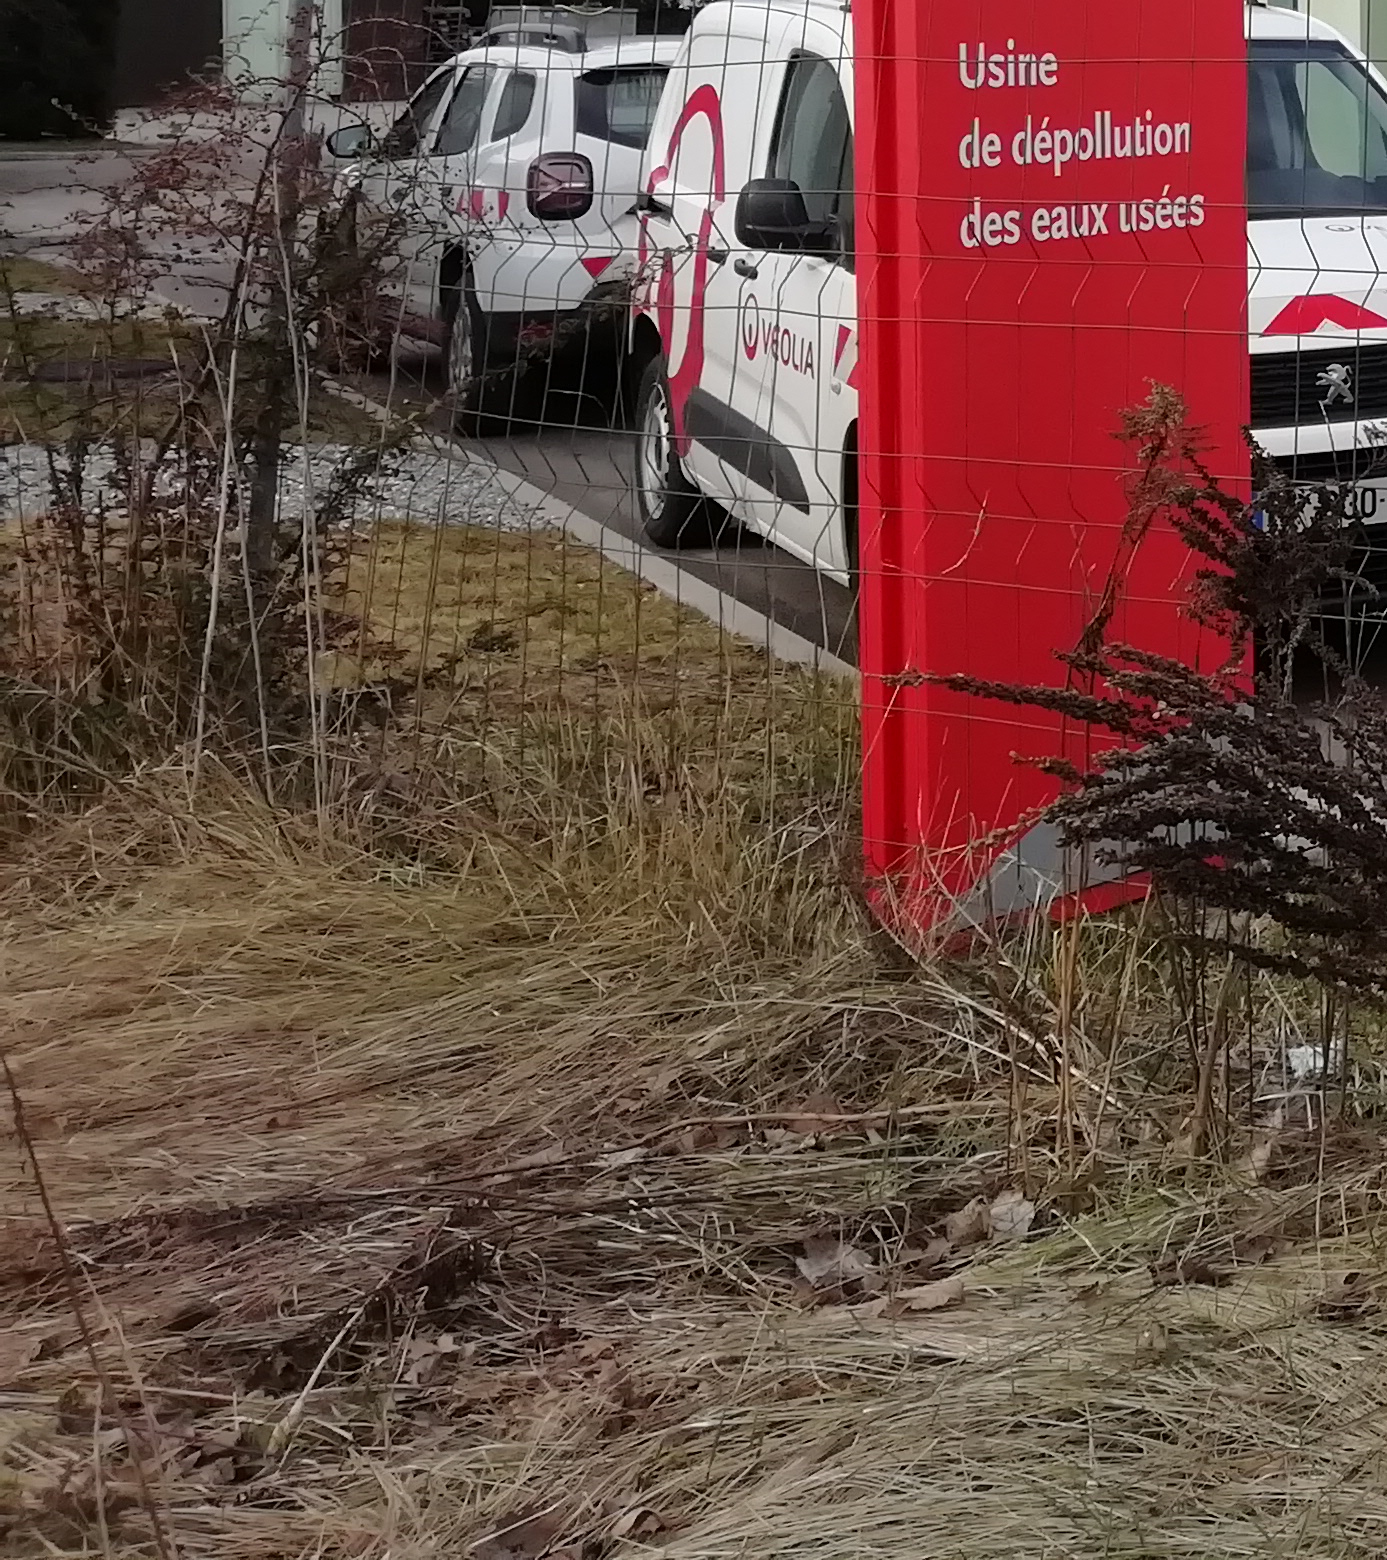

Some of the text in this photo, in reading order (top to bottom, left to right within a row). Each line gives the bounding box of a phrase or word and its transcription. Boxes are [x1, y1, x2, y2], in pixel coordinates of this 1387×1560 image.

[958, 38, 1059, 89] Usine
[958, 108, 1191, 177] de dépollution
[960, 183, 1206, 249] des eaux usées
[762, 317, 815, 380] VEOLIA
